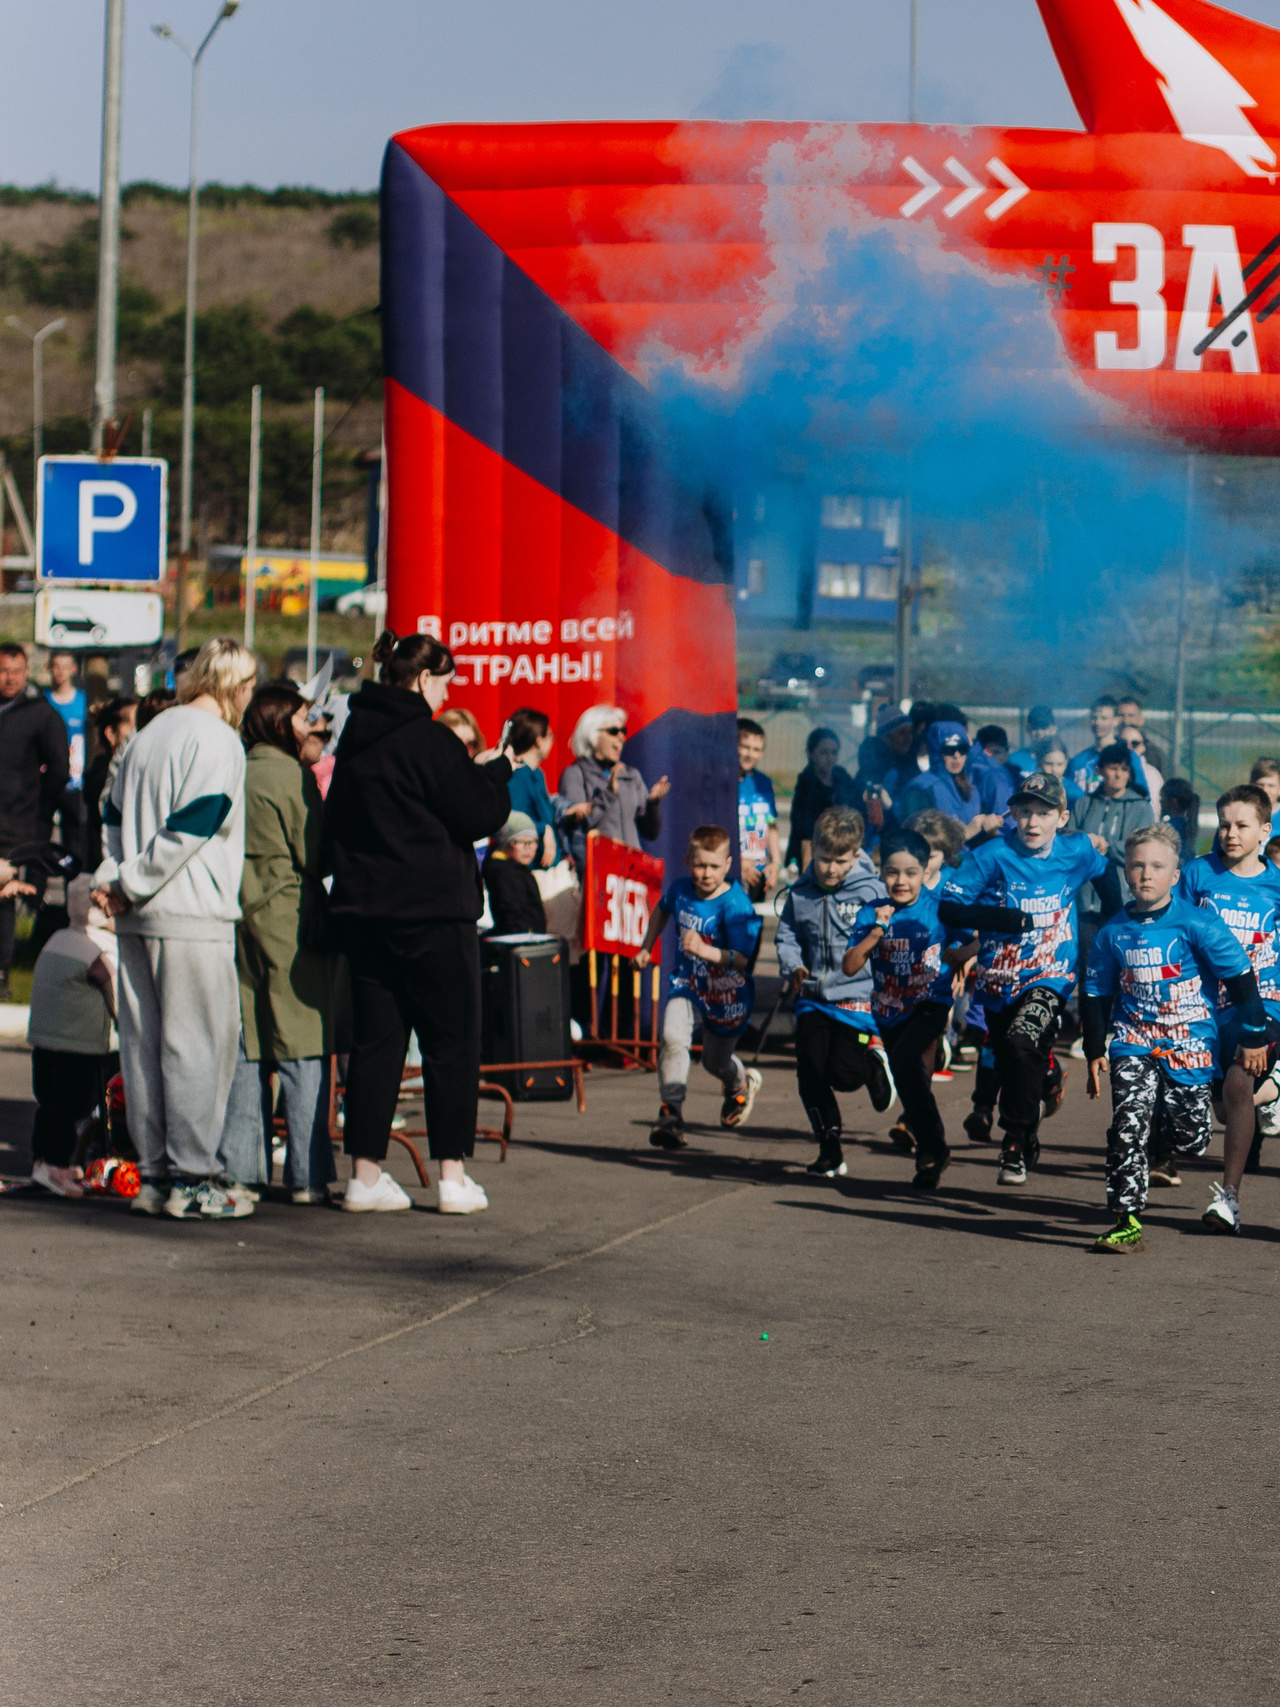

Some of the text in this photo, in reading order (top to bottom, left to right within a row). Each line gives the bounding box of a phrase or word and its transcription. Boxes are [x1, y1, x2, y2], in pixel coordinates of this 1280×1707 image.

[78, 480, 137, 566] P
[450, 620, 552, 650] ритме
[561, 610, 635, 643] всей
[1021, 894, 1060, 914] 00525
[1220, 908, 1260, 930] 00514
[1125, 947, 1163, 966] 00516
